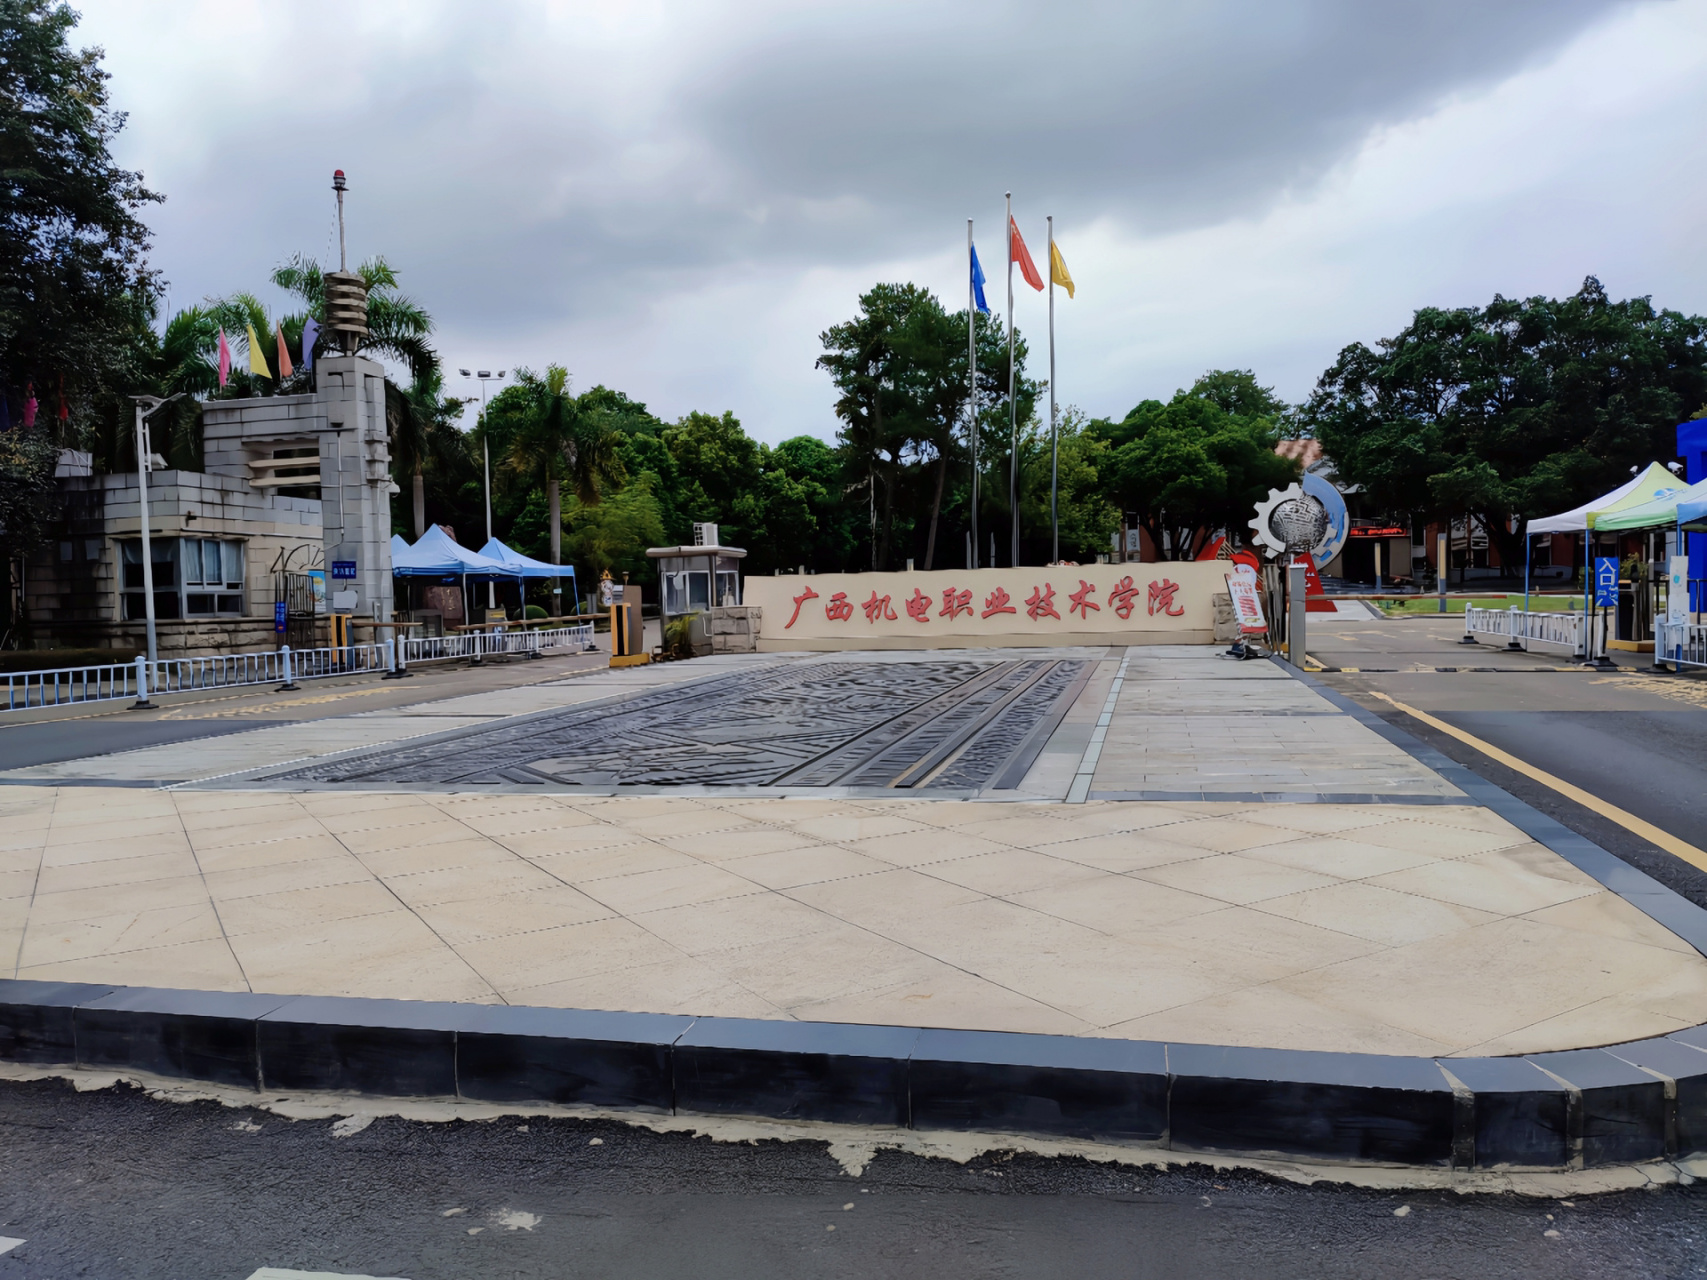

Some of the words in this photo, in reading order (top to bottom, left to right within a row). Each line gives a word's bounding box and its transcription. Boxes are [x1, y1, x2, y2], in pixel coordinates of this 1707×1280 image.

[1599, 558, 1616, 586] 入口
[784, 575, 1184, 629] 广西机电职业技术学院
